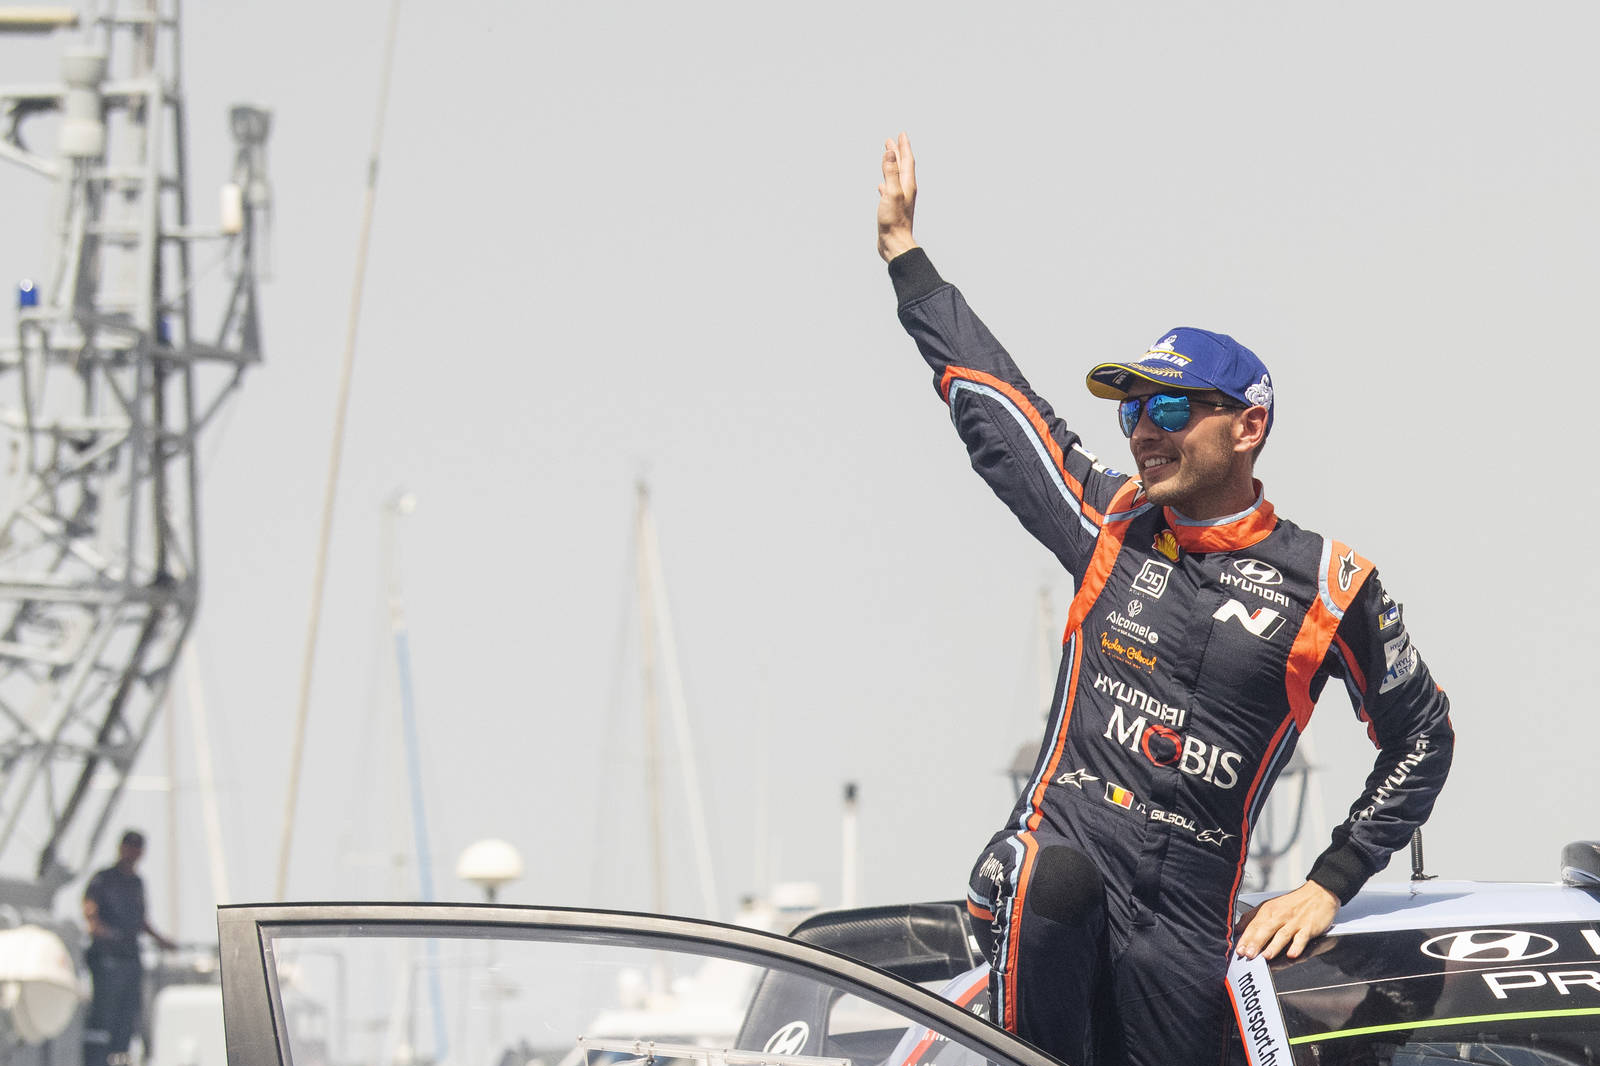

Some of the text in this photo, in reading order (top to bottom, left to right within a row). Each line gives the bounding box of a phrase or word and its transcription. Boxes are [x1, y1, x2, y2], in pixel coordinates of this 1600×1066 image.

[1220, 573, 1290, 607] HYUNDAI
[1106, 611, 1150, 637] Alcomel
[1094, 673, 1186, 727] HYUNDAI
[1103, 704, 1242, 790] MOBIS
[1151, 809, 1196, 832] GILSOUL
